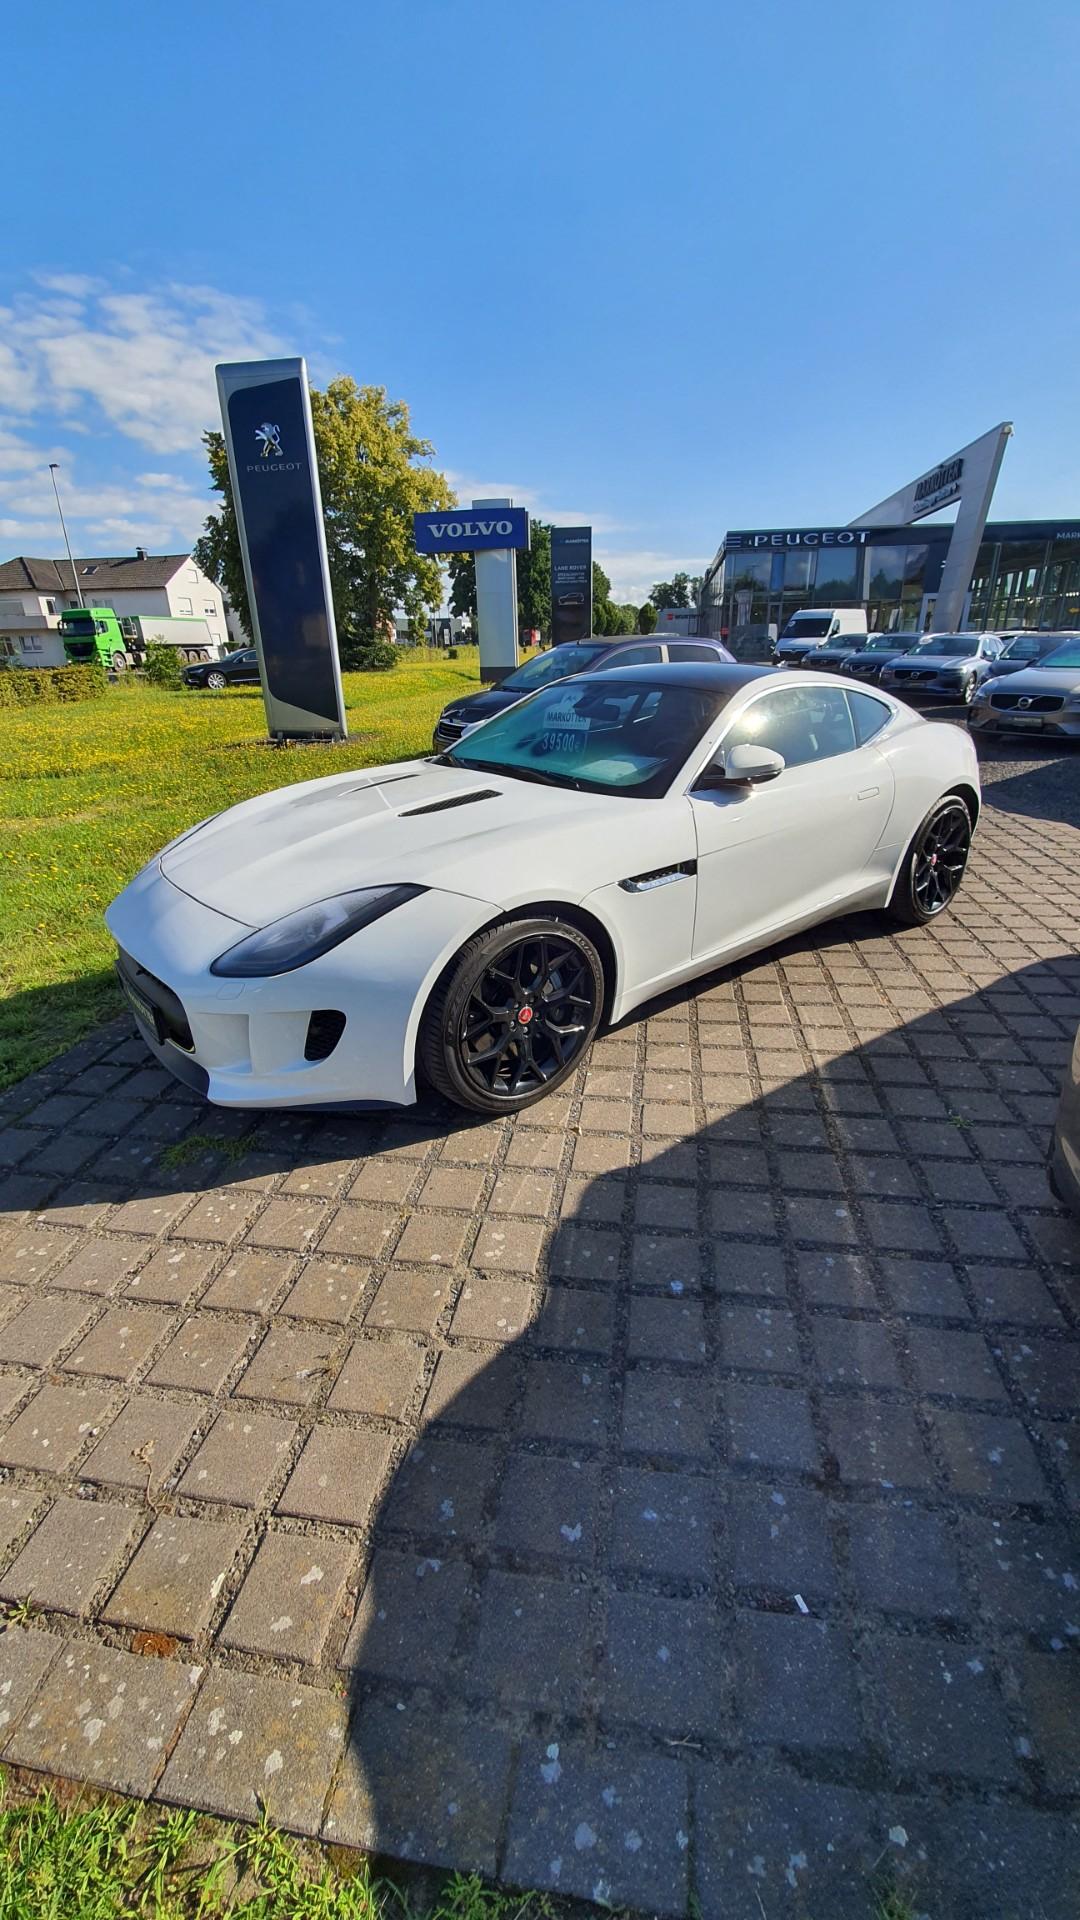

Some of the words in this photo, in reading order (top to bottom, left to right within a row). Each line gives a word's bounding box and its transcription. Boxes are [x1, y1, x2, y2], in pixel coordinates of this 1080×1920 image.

[246, 462, 303, 473] PEUGEOT
[427, 520, 513, 538] VOLVO
[754, 531, 871, 547] PEUGEOT
